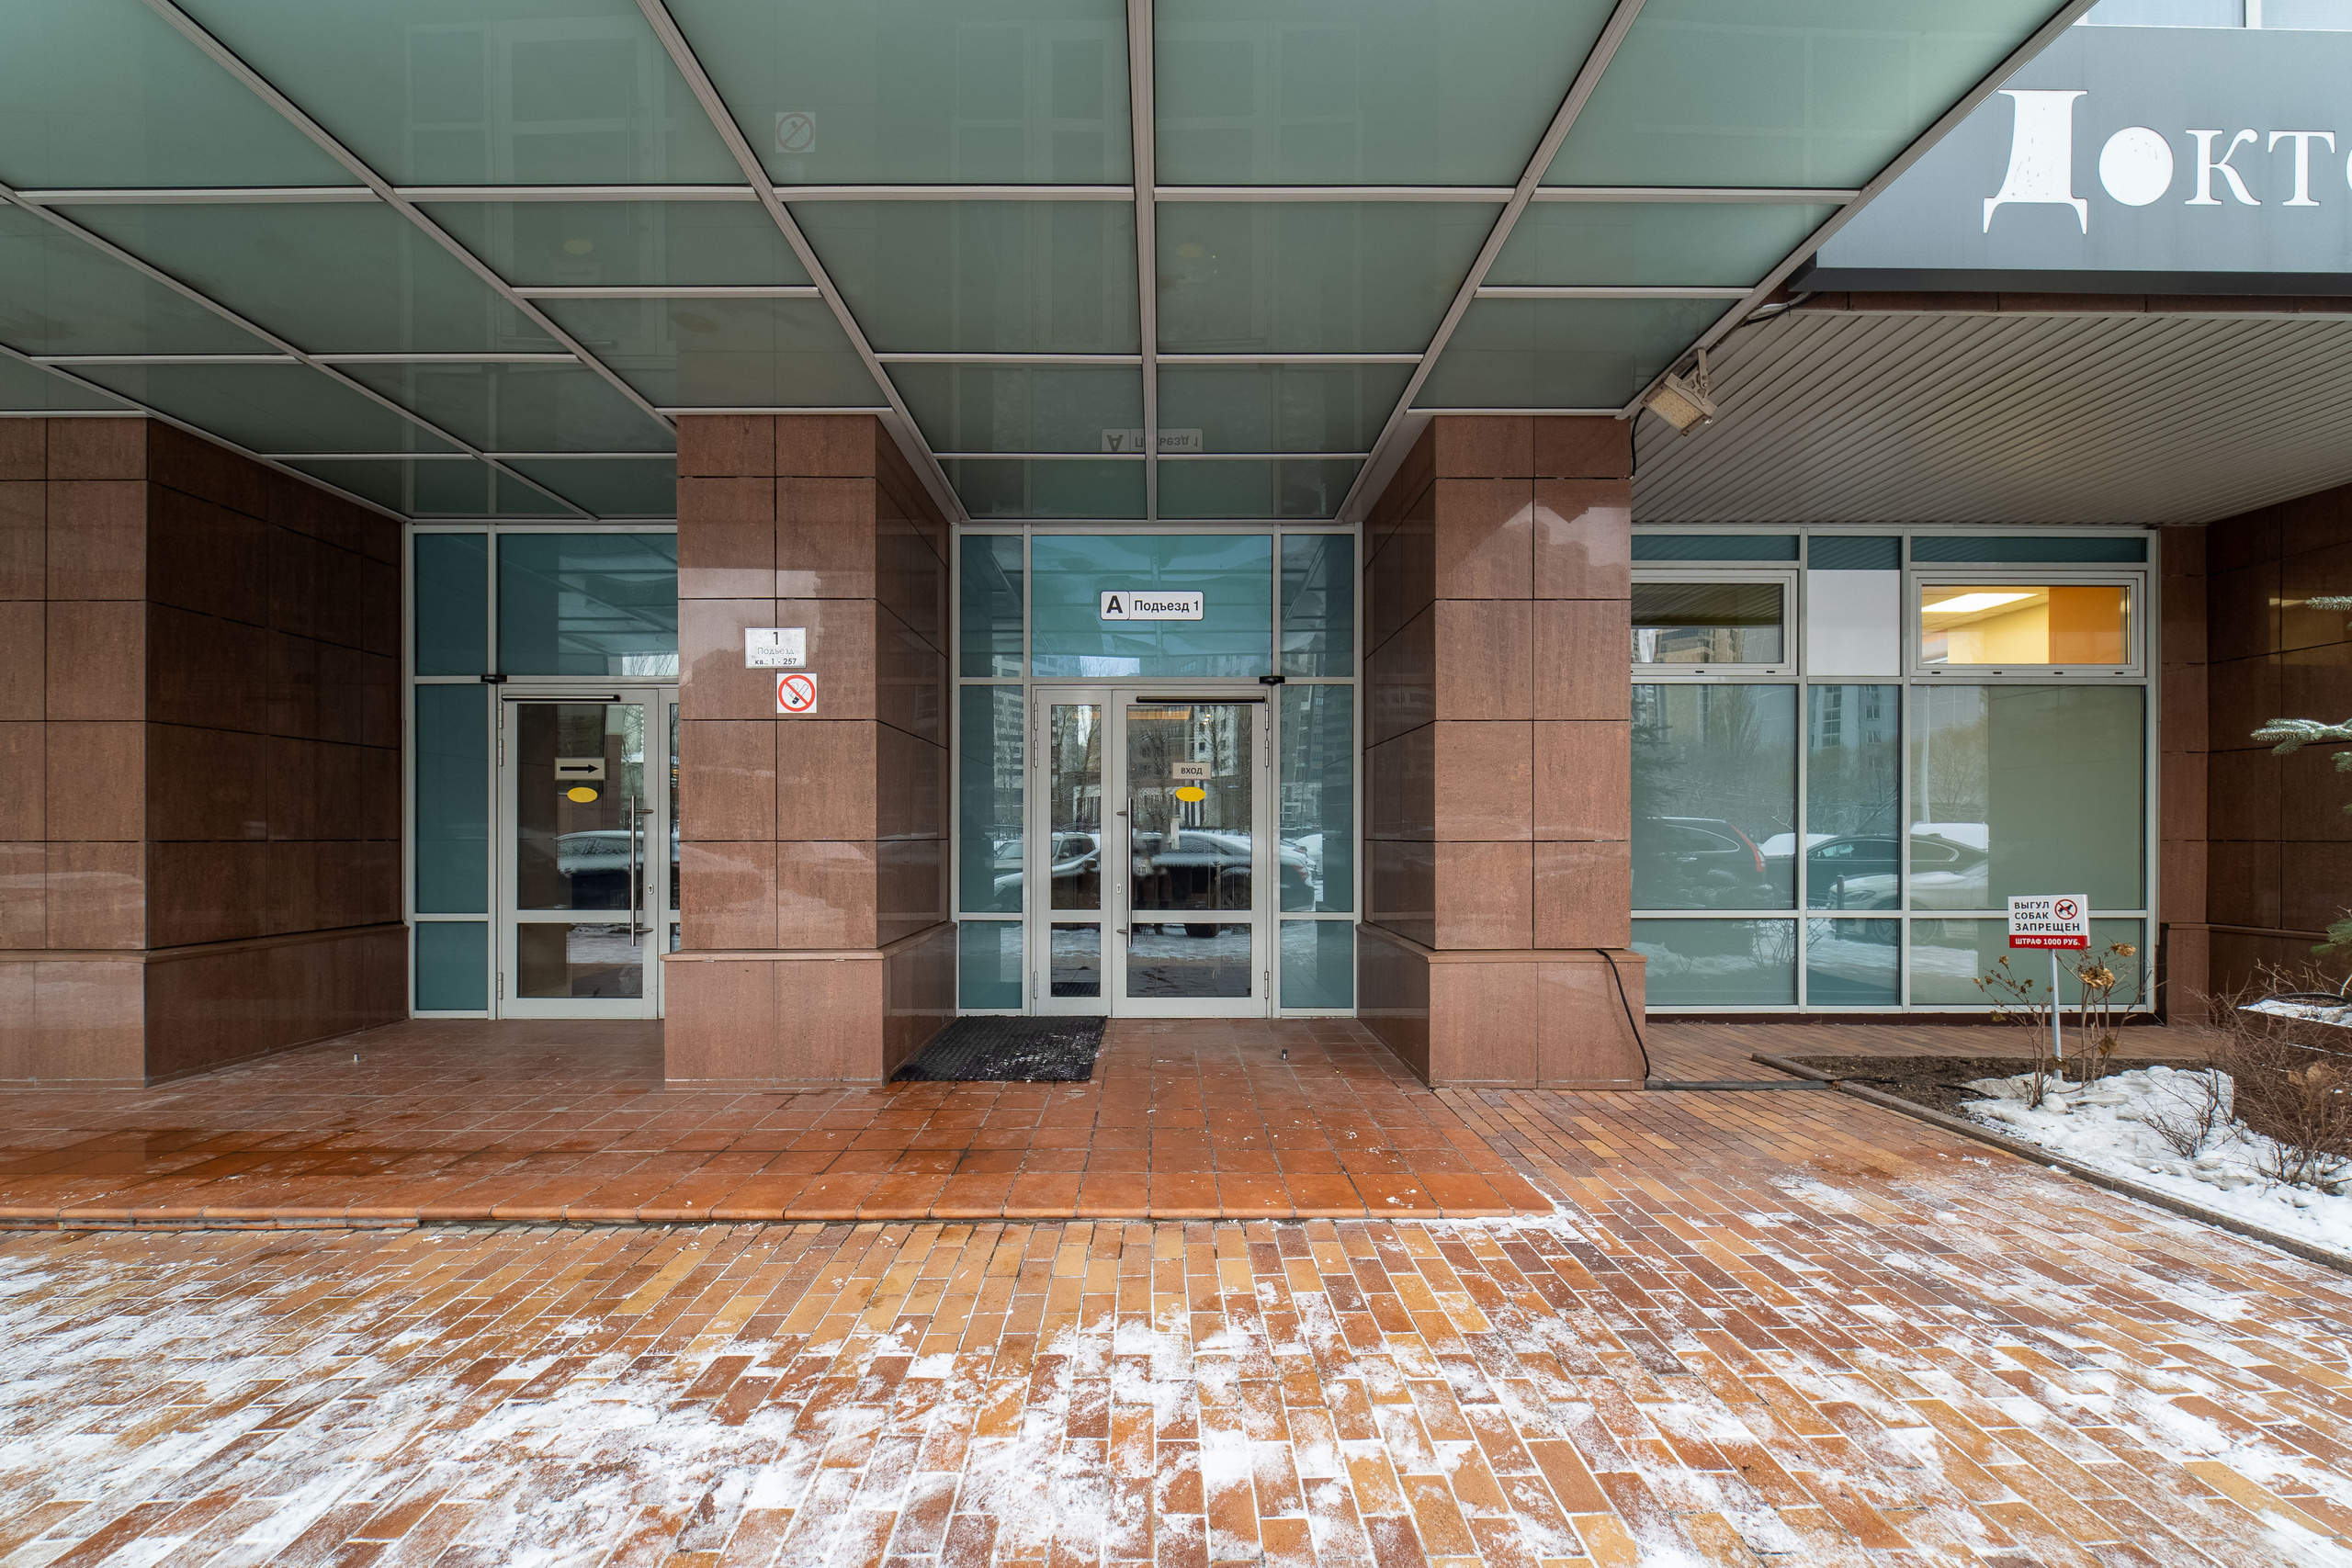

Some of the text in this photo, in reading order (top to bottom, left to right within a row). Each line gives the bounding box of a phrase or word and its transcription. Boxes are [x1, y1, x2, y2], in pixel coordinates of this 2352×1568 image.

[1983, 88, 2352, 235] Докт
[1105, 594, 1199, 614] А Подъезд 1
[773, 631, 779, 645] 1
[1181, 767, 1203, 775] ВХОД
[2014, 901, 2050, 909] ВЫГУЛ
[2014, 911, 2049, 919] СОБАК
[2015, 922, 2080, 932] ЗАПРЕЩЕН
[2063, 938, 2081, 946] РУБ.
